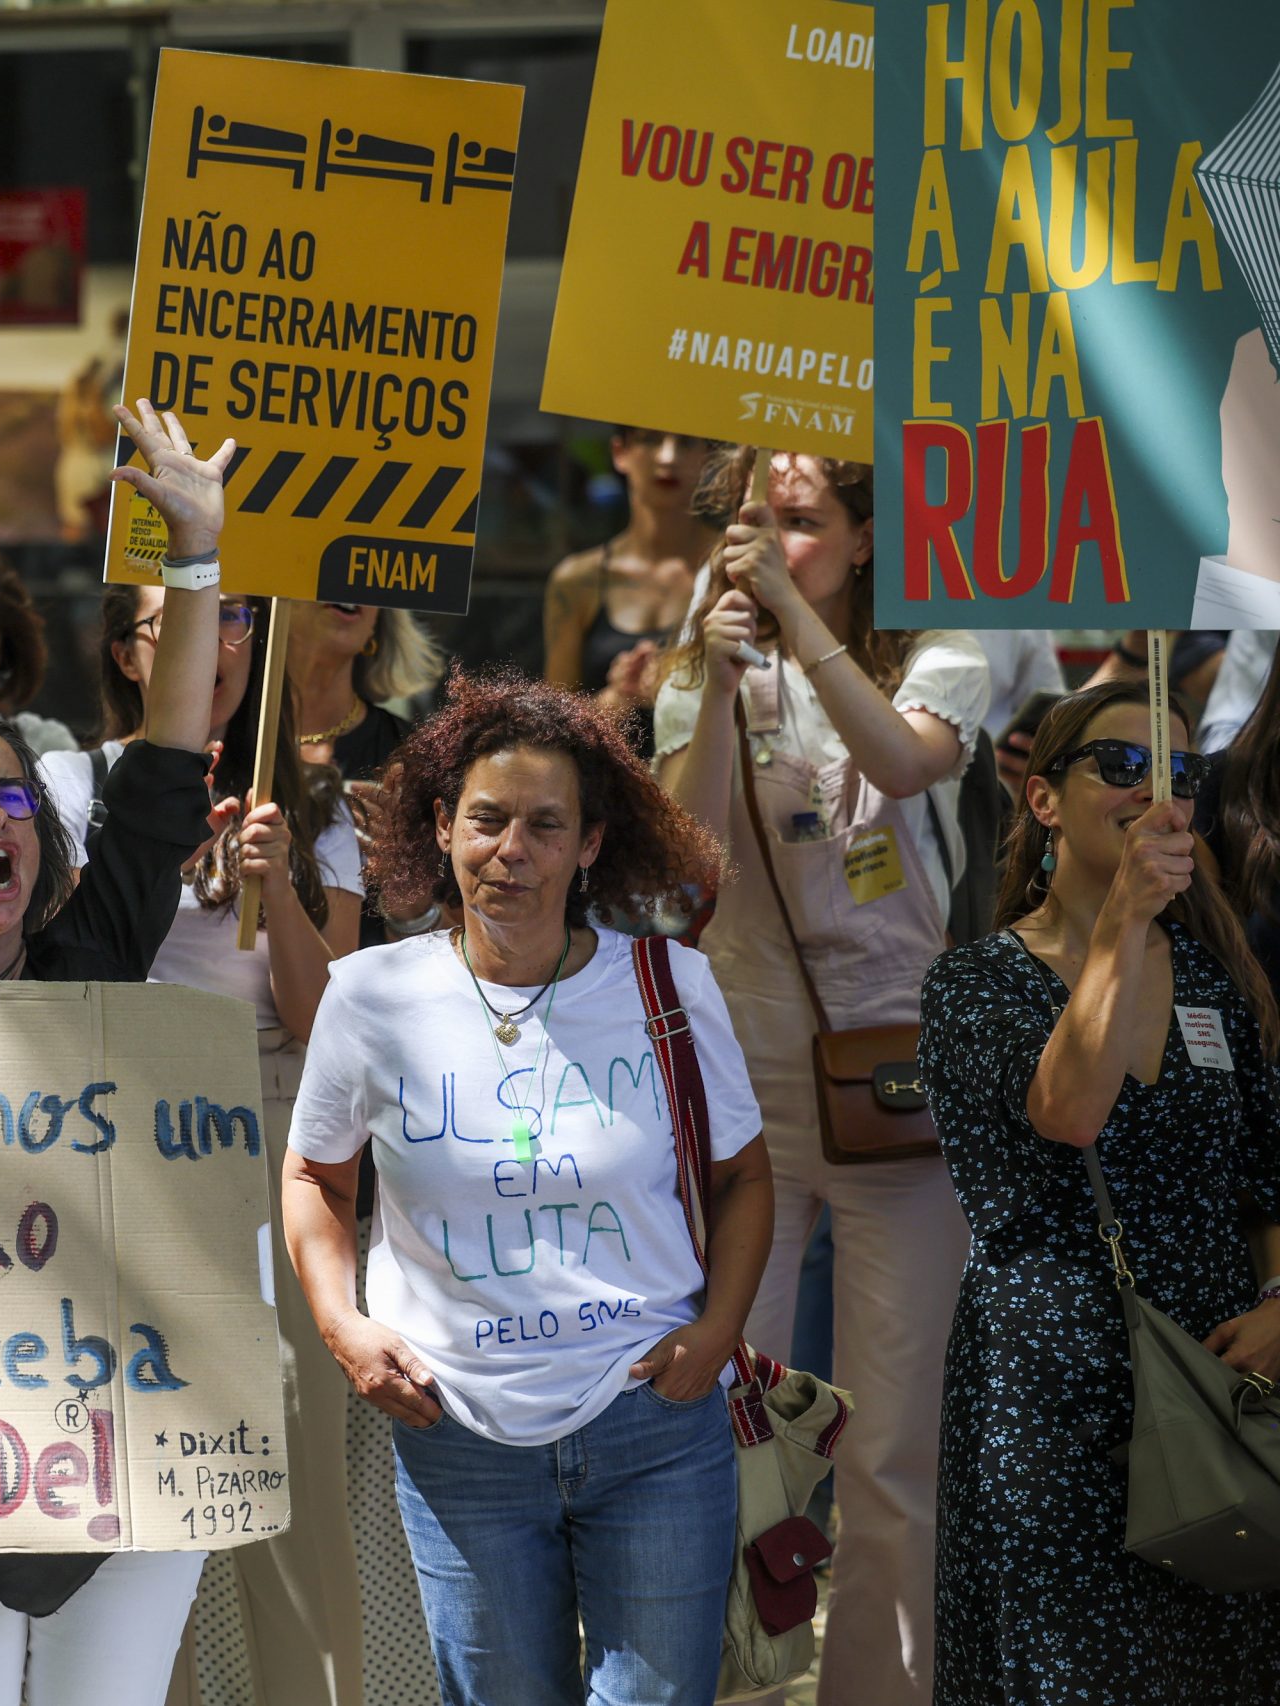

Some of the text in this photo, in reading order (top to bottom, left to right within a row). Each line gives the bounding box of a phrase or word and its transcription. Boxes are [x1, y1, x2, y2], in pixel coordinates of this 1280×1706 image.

[786, 24, 874, 71] LOADI
[924, 0, 1133, 151] HOJE
[621, 119, 874, 215] VOU SER OB
[162, 210, 317, 282] NÃO AO
[906, 138, 1223, 294] A AULA
[677, 221, 874, 304] A EMIGR
[155, 284, 478, 363] ENCERRAMENTO
[912, 269, 1085, 419] É NA
[150, 351, 470, 450] DE SERVIÇOS
[764, 403, 854, 436] FNAM
[129, 536, 167, 548] DE QUALIDA
[130, 527, 151, 536] MÉDICO
[131, 518, 162, 529] INTERNATO
[902, 416, 1131, 604] RUA
[347, 547, 438, 593] FNAM
[154, 1095, 260, 1161] um
[399, 1051, 661, 1144] ULSAM
[494, 1153, 582, 1198] EM
[443, 1201, 631, 1282] LUTA
[476, 1297, 642, 1348] PELO SNS
[158, 1467, 184, 1497] M.
